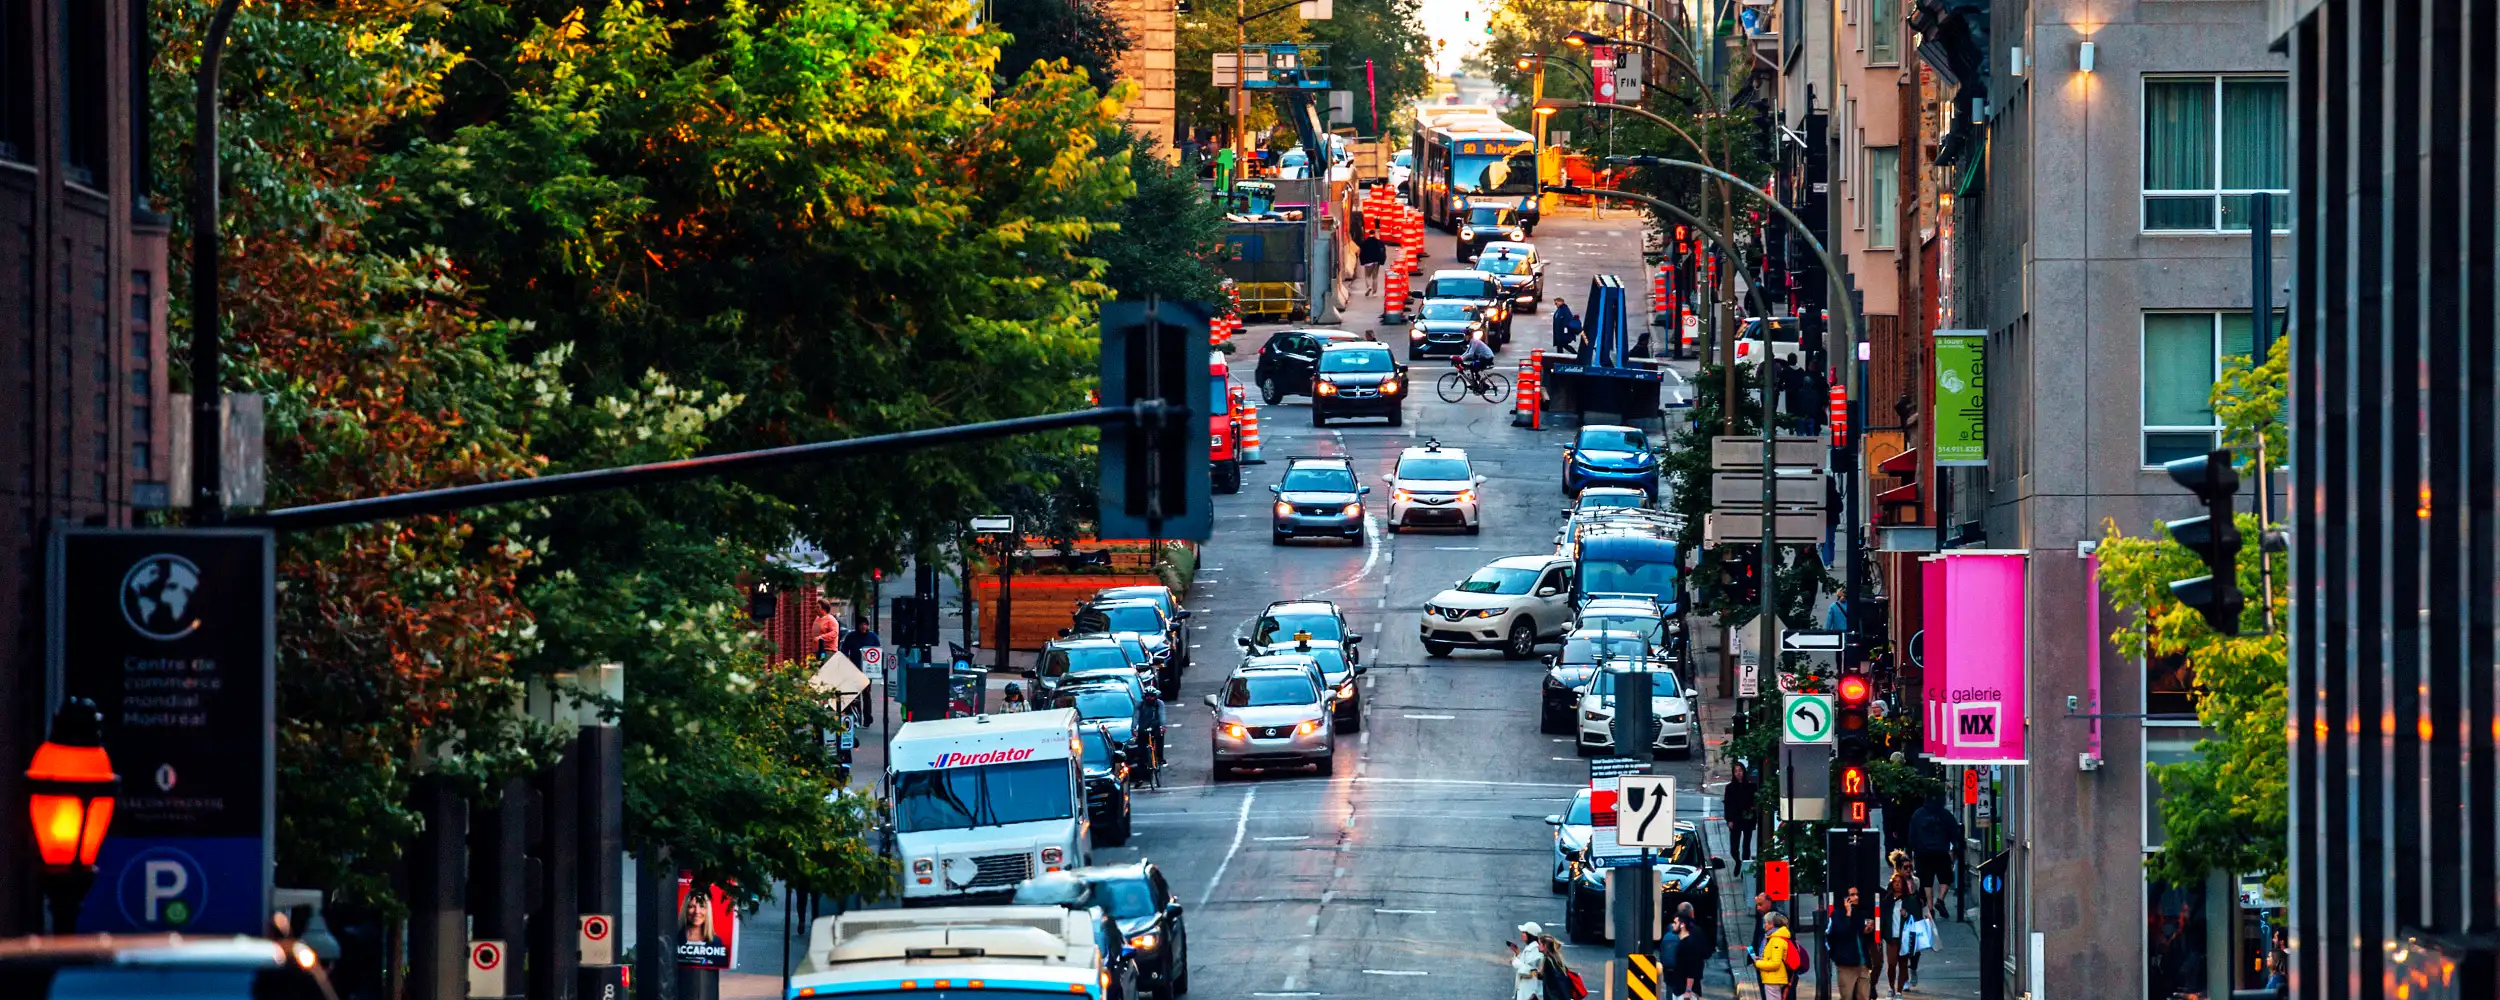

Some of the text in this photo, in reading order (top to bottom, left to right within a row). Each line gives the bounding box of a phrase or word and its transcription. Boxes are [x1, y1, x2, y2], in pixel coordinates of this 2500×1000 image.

[1620, 77, 1637, 88] FIN
[1967, 343, 1984, 388] neuf
[1959, 395, 1984, 441] mille
[1959, 430, 1969, 441] le
[124, 657, 215, 671] Centre de
[1745, 665, 1754, 677] P
[124, 676, 221, 689] commerce
[124, 693, 200, 707] mondial
[1952, 687, 2001, 704] galerie
[1960, 714, 1995, 735] MX
[947, 747, 1035, 767] Purolator
[145, 861, 188, 921] P
